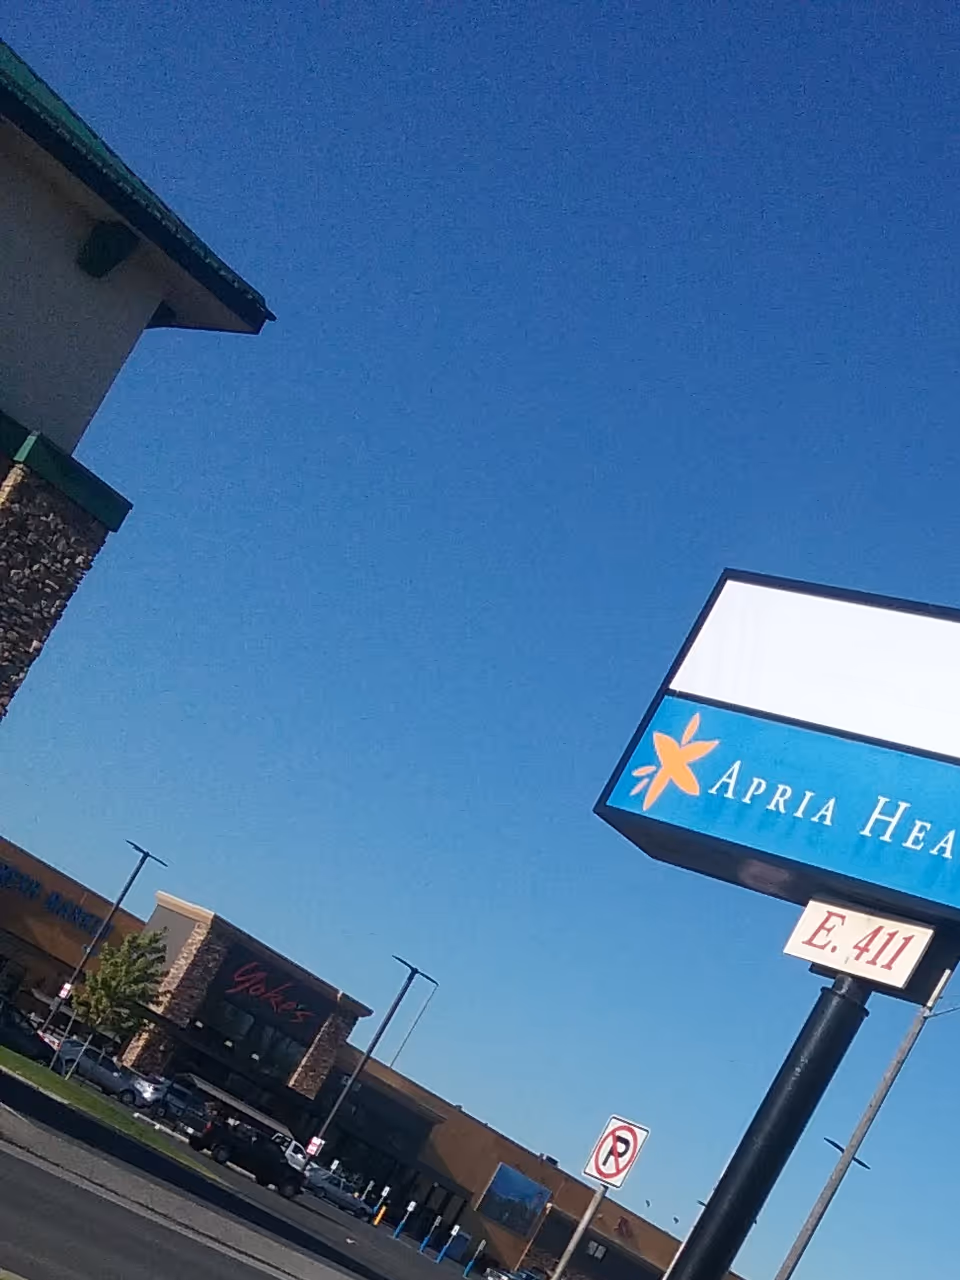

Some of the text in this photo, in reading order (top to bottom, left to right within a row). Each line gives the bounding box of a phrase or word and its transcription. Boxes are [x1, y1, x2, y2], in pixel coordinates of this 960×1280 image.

[707, 759, 837, 826] APRIA
[801, 910, 915, 971] E. 411
